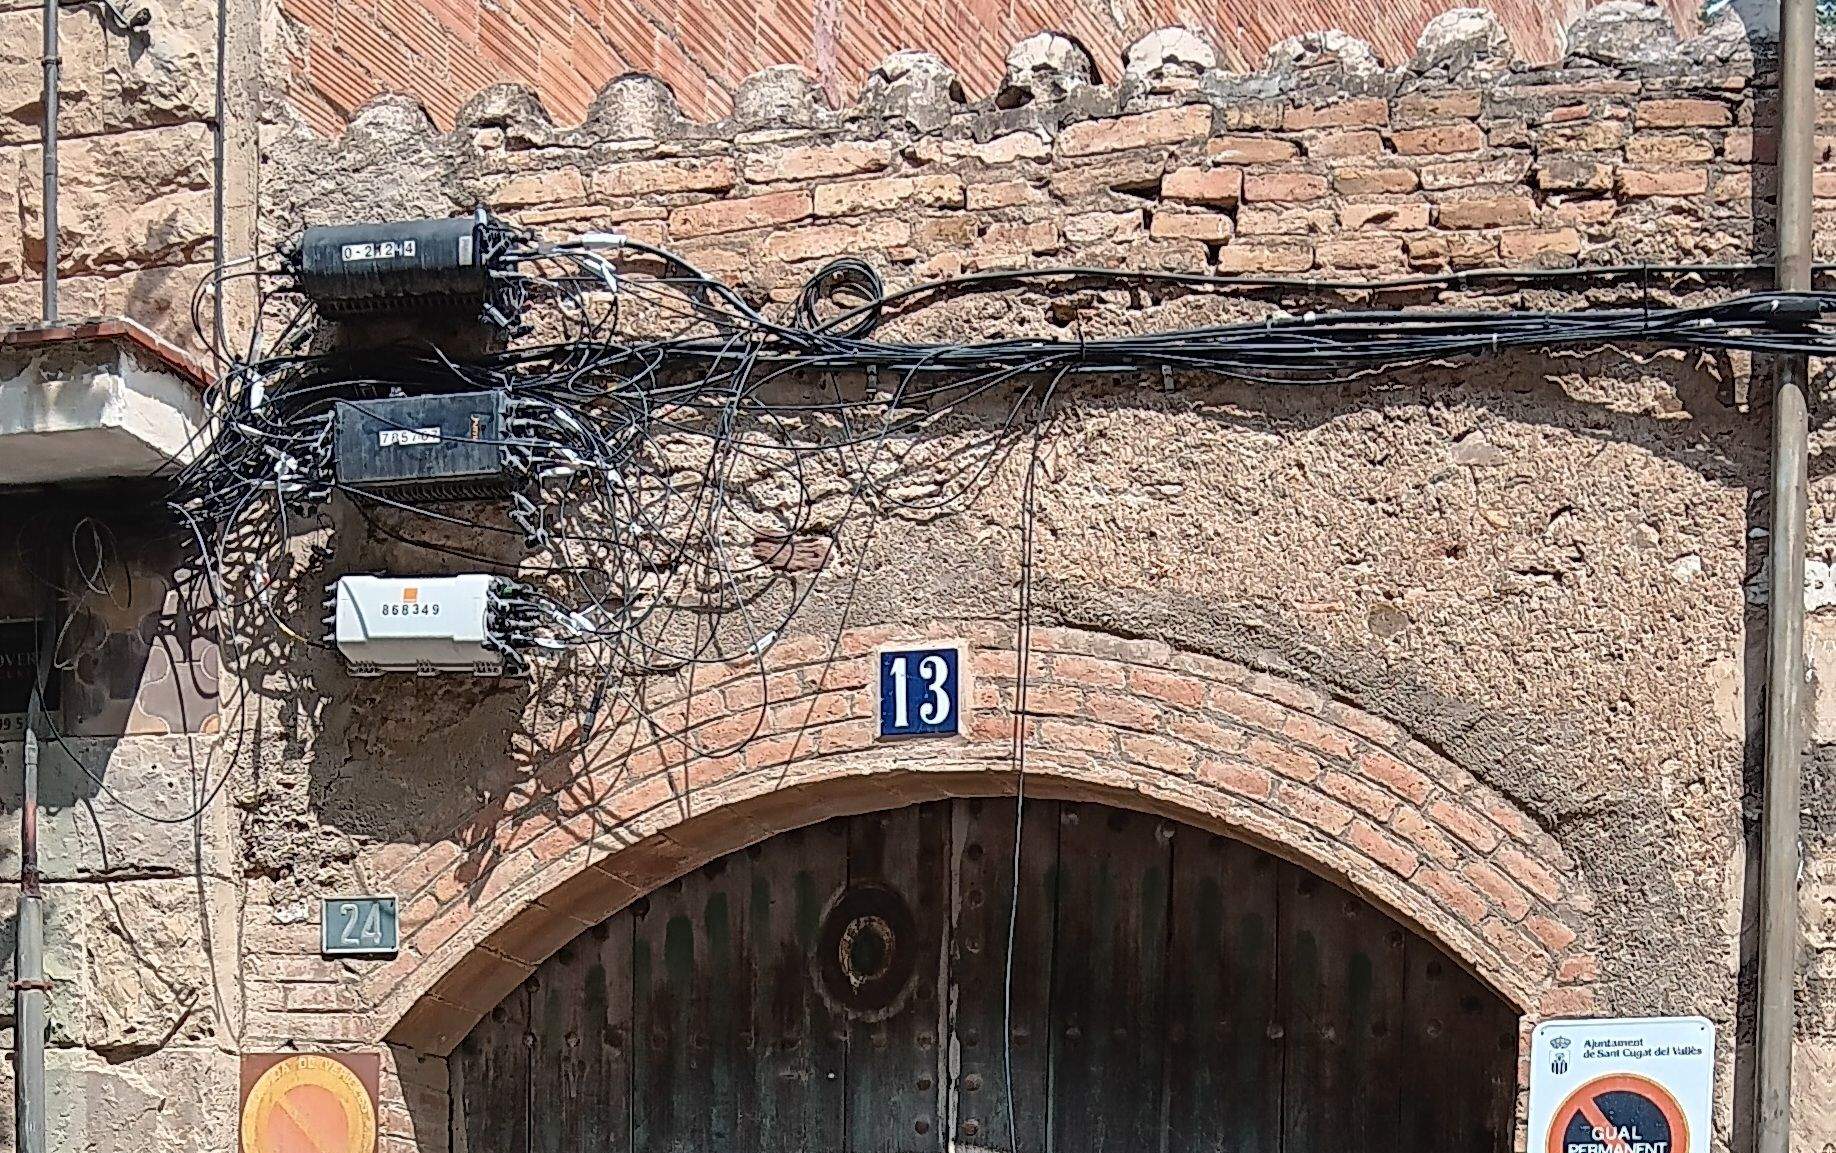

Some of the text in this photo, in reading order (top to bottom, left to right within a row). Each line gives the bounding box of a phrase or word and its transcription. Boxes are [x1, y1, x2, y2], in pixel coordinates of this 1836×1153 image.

[382, 603, 440, 616] 868349
[889, 655, 951, 728] 13
[340, 903, 382, 946] 24
[1584, 1039, 1644, 1050] Ajuntament
[1583, 1049, 1596, 1058] de
[1597, 1049, 1620, 1058] Sant
[1622, 1048, 1652, 1059] Cugat
[1654, 1046, 1670, 1056] del
[1592, 1125, 1643, 1141] GUAL
